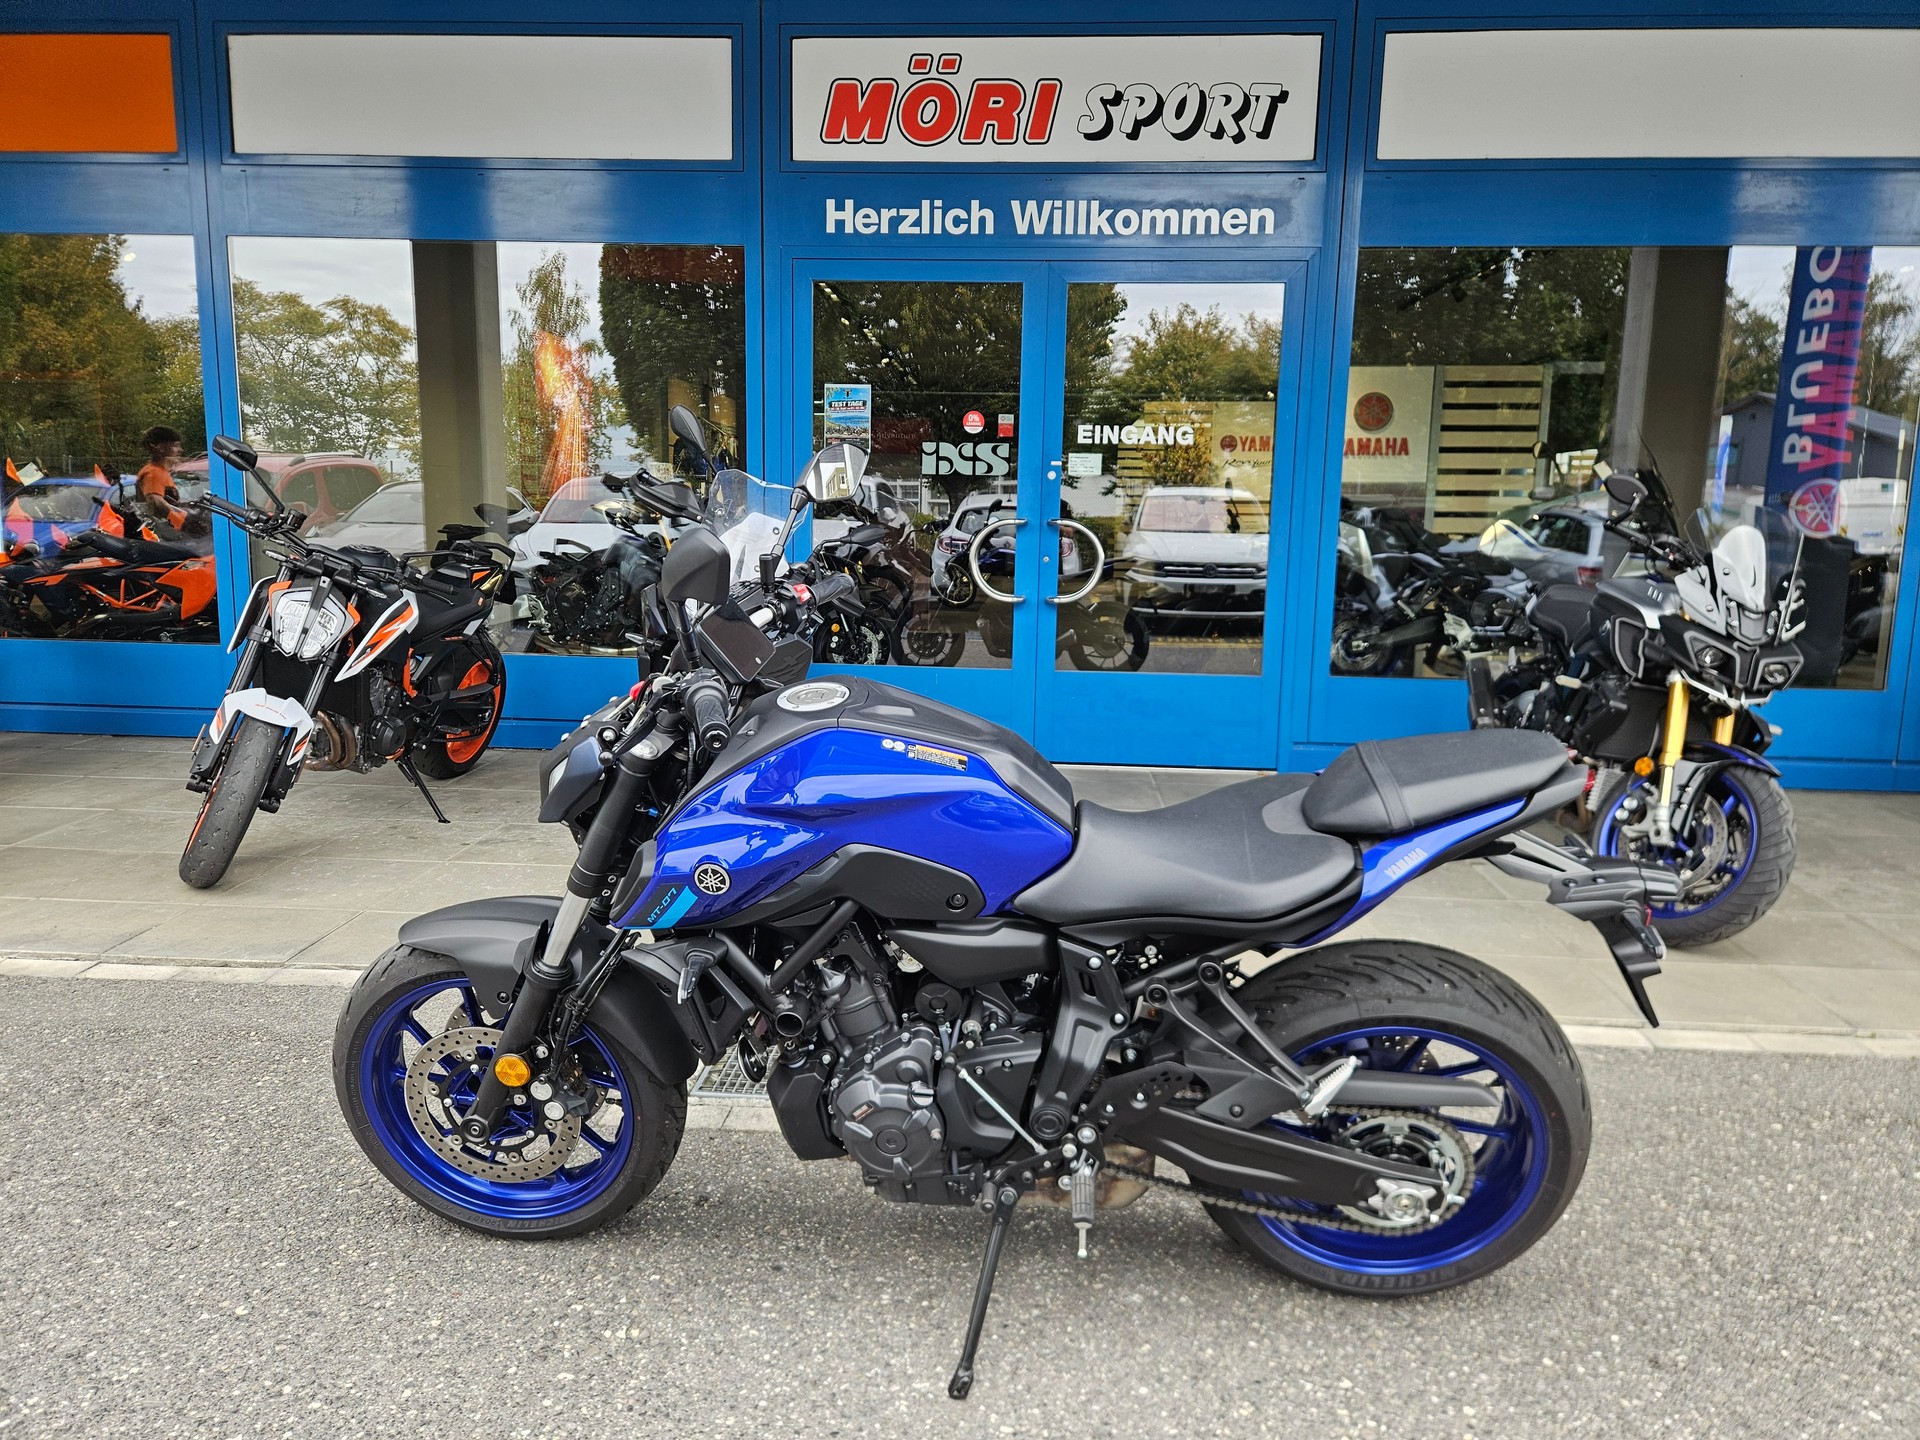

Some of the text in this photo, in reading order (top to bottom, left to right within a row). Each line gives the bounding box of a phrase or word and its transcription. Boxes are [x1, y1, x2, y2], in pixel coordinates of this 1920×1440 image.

[820, 53, 1289, 146] MÖRI SPORT
[826, 199, 1274, 236] Herzlich Willkommen
[1077, 424, 1194, 445] EINGANG
[1239, 435, 1271, 452] YAM
[1343, 437, 1409, 457] AMAHA
[1384, 848, 1428, 880] YAMAHA
[647, 887, 677, 922] MT-07
[1341, 1265, 1457, 1288] MICHELIN
